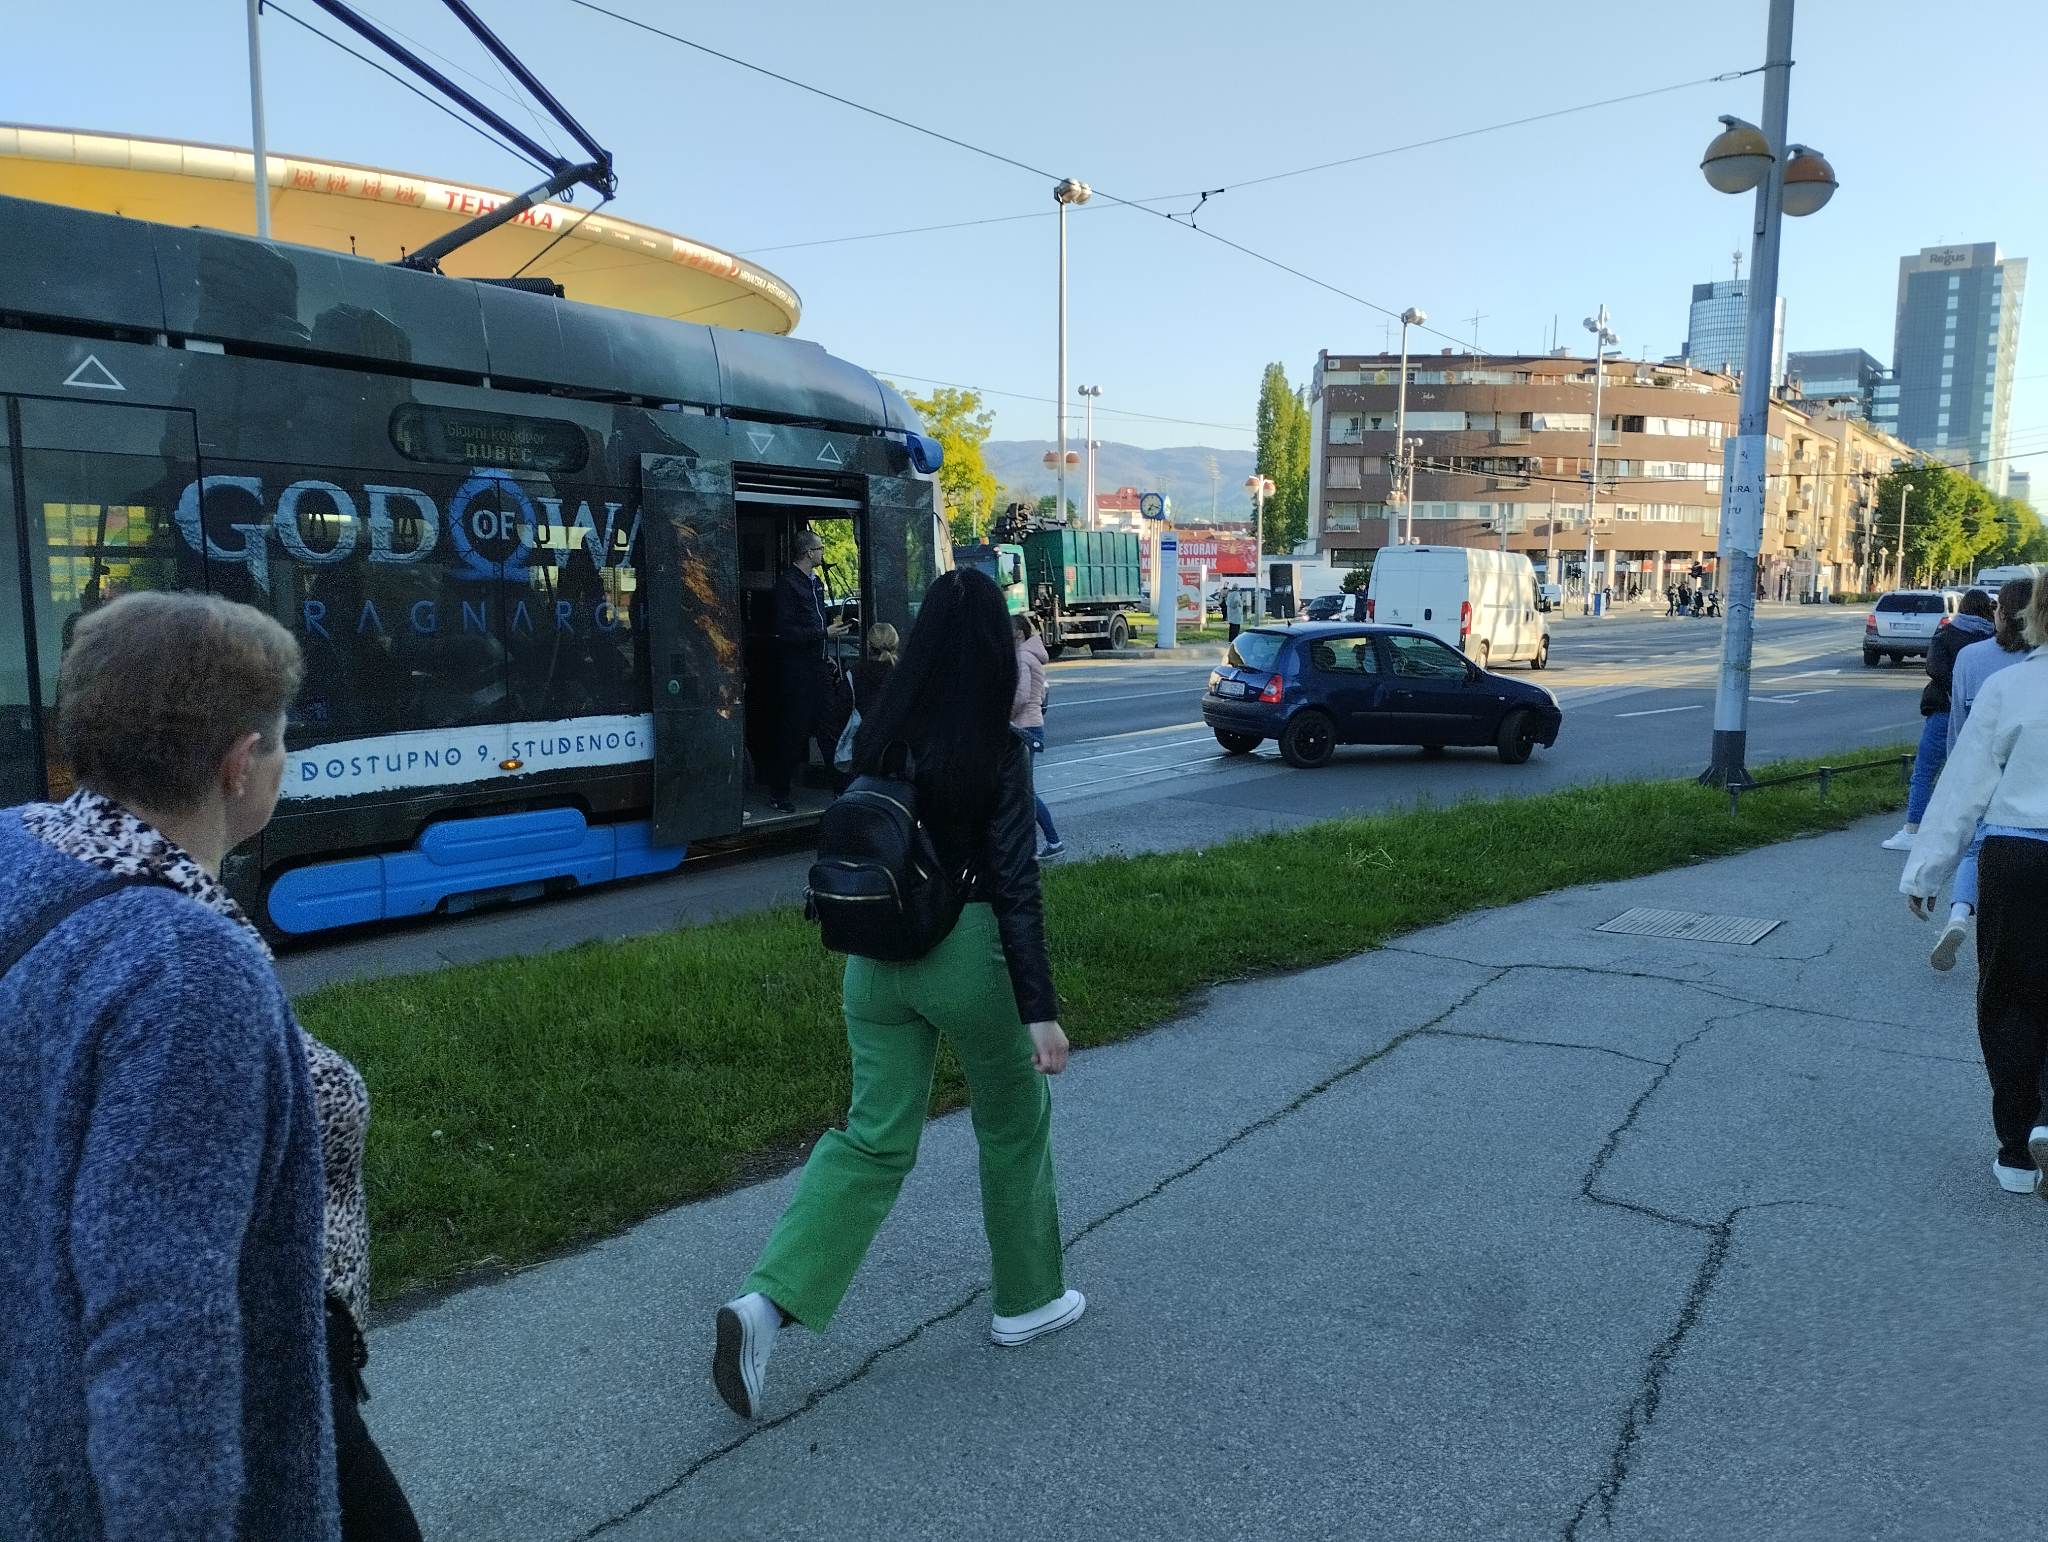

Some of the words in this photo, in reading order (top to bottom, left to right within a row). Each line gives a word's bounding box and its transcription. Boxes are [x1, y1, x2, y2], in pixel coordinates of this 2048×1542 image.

[293, 168, 316, 187] kik
[326, 173, 348, 193] kik
[362, 179, 383, 198] kik
[395, 184, 416, 203] kik
[444, 191, 553, 230] TEHIKA
[1929, 252, 1966, 266] Regus
[465, 442, 532, 463] DUBEC
[174, 475, 440, 596] GOD
[472, 509, 517, 542] OF
[1178, 543, 1217, 556] ESTORAN
[301, 746, 462, 782] DOSTUPNO
[477, 744, 496, 761] 9.
